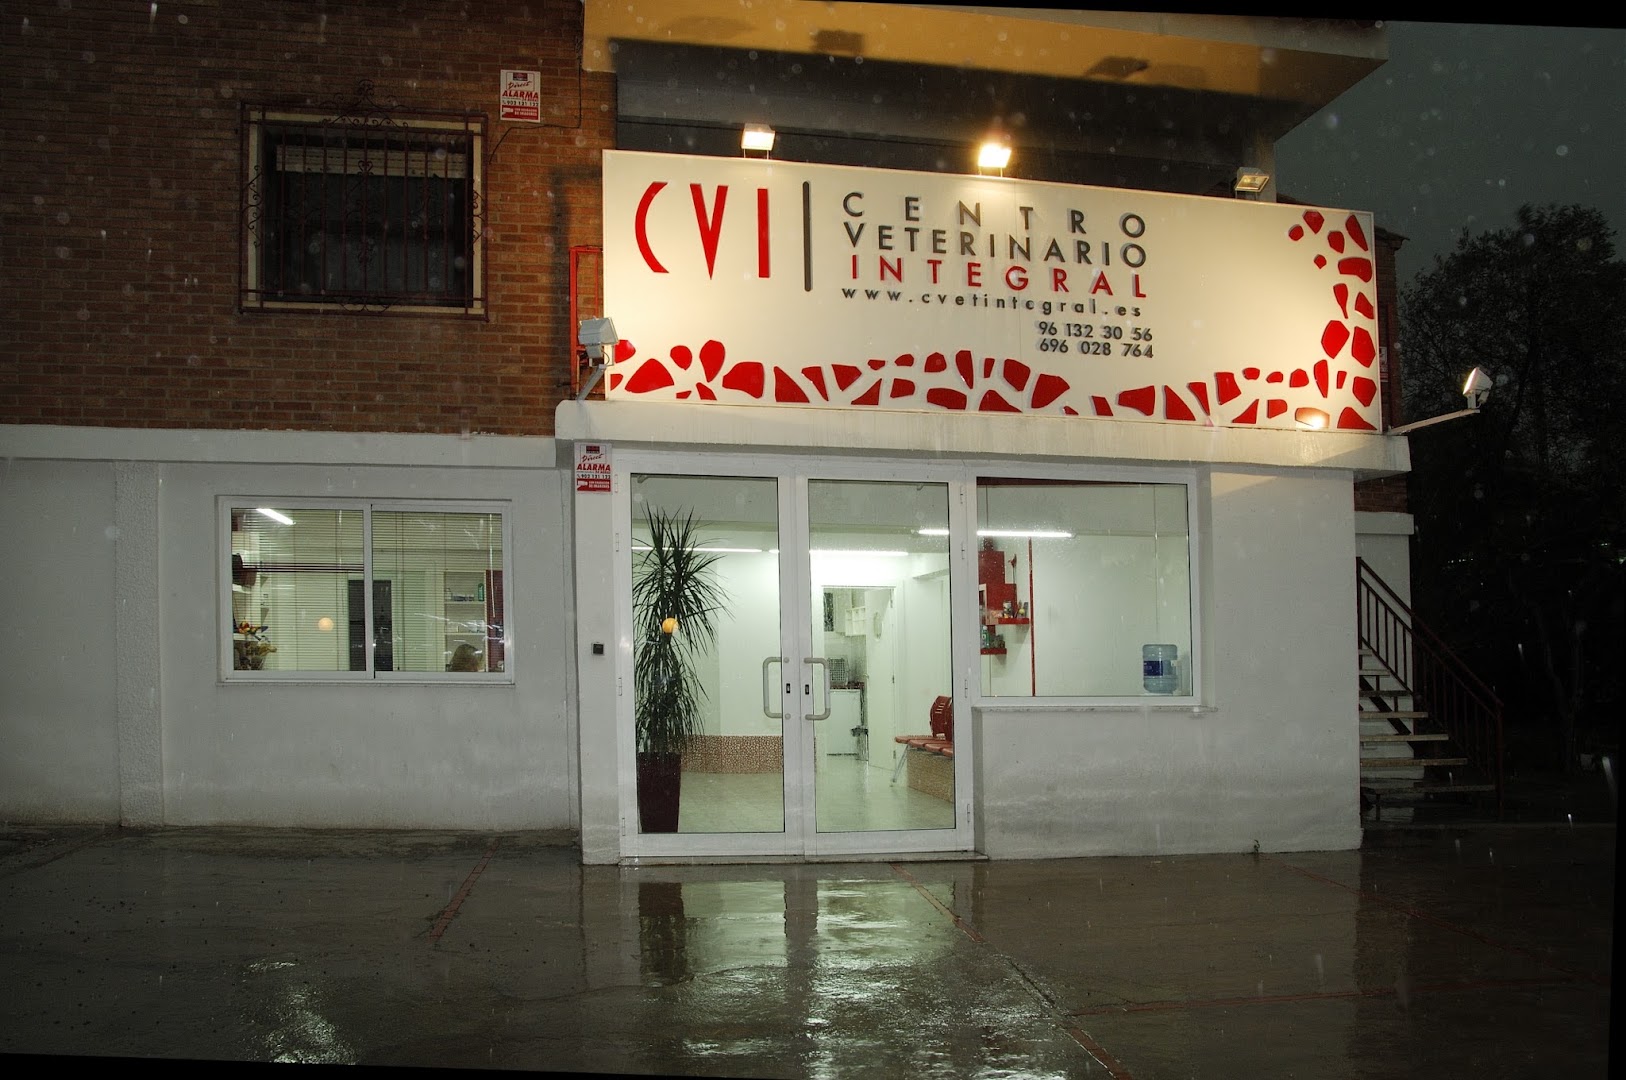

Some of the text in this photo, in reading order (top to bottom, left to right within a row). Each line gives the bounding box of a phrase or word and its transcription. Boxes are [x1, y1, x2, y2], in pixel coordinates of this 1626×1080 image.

[502, 90, 539, 99] ALARMA
[508, 81, 532, 89] Direct
[842, 191, 1146, 239] CENTRO
[635, 181, 770, 280] CVI
[843, 221, 1147, 269] VETERINARIO
[851, 254, 1147, 299] INTEGRAL
[842, 287, 1142, 317] www.cvetintegral.es
[1038, 321, 1153, 341] 96 132 30 56
[1039, 338, 1154, 358] 696 028 764
[577, 463, 611, 471] ALARMA
[582, 453, 604, 462] Direct
